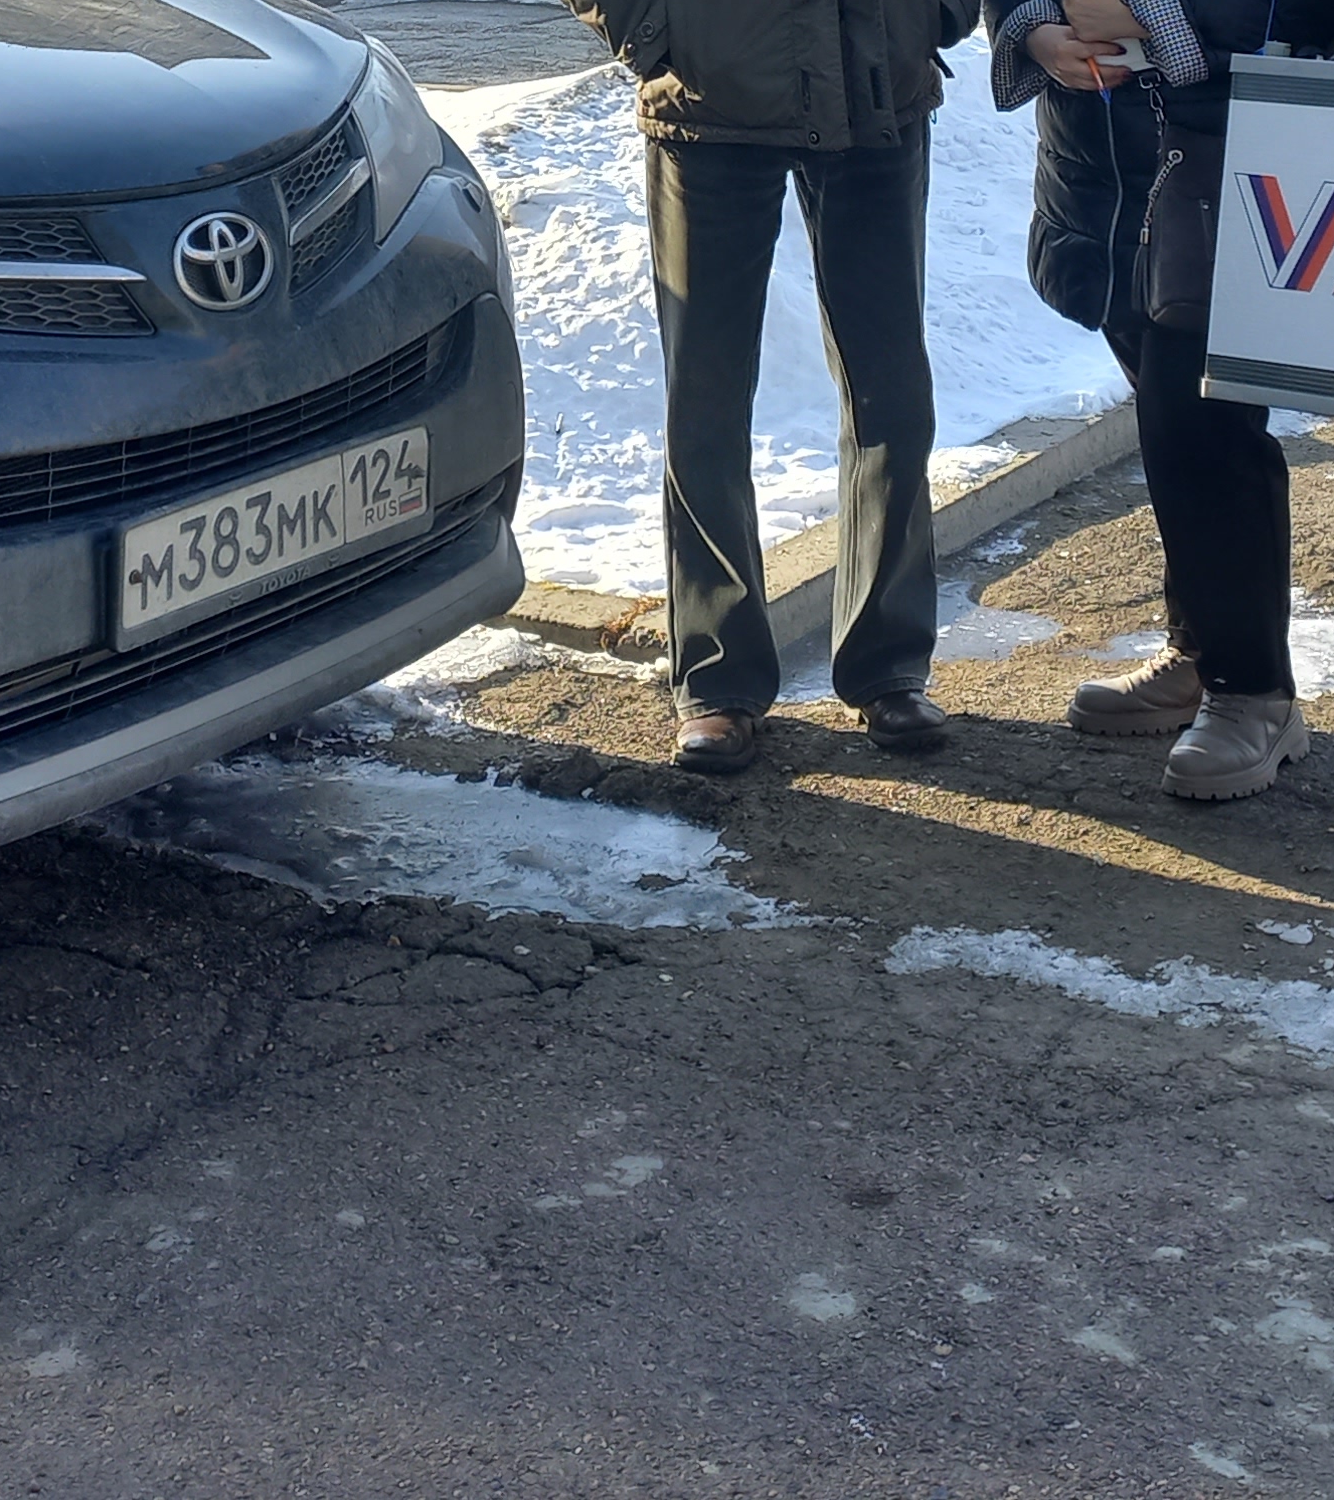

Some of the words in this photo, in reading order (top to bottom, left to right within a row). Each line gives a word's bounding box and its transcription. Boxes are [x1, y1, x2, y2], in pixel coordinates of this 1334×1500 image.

[349, 440, 426, 508] 124
[364, 502, 398, 528] RUS
[259, 565, 311, 596] TOYOTA
